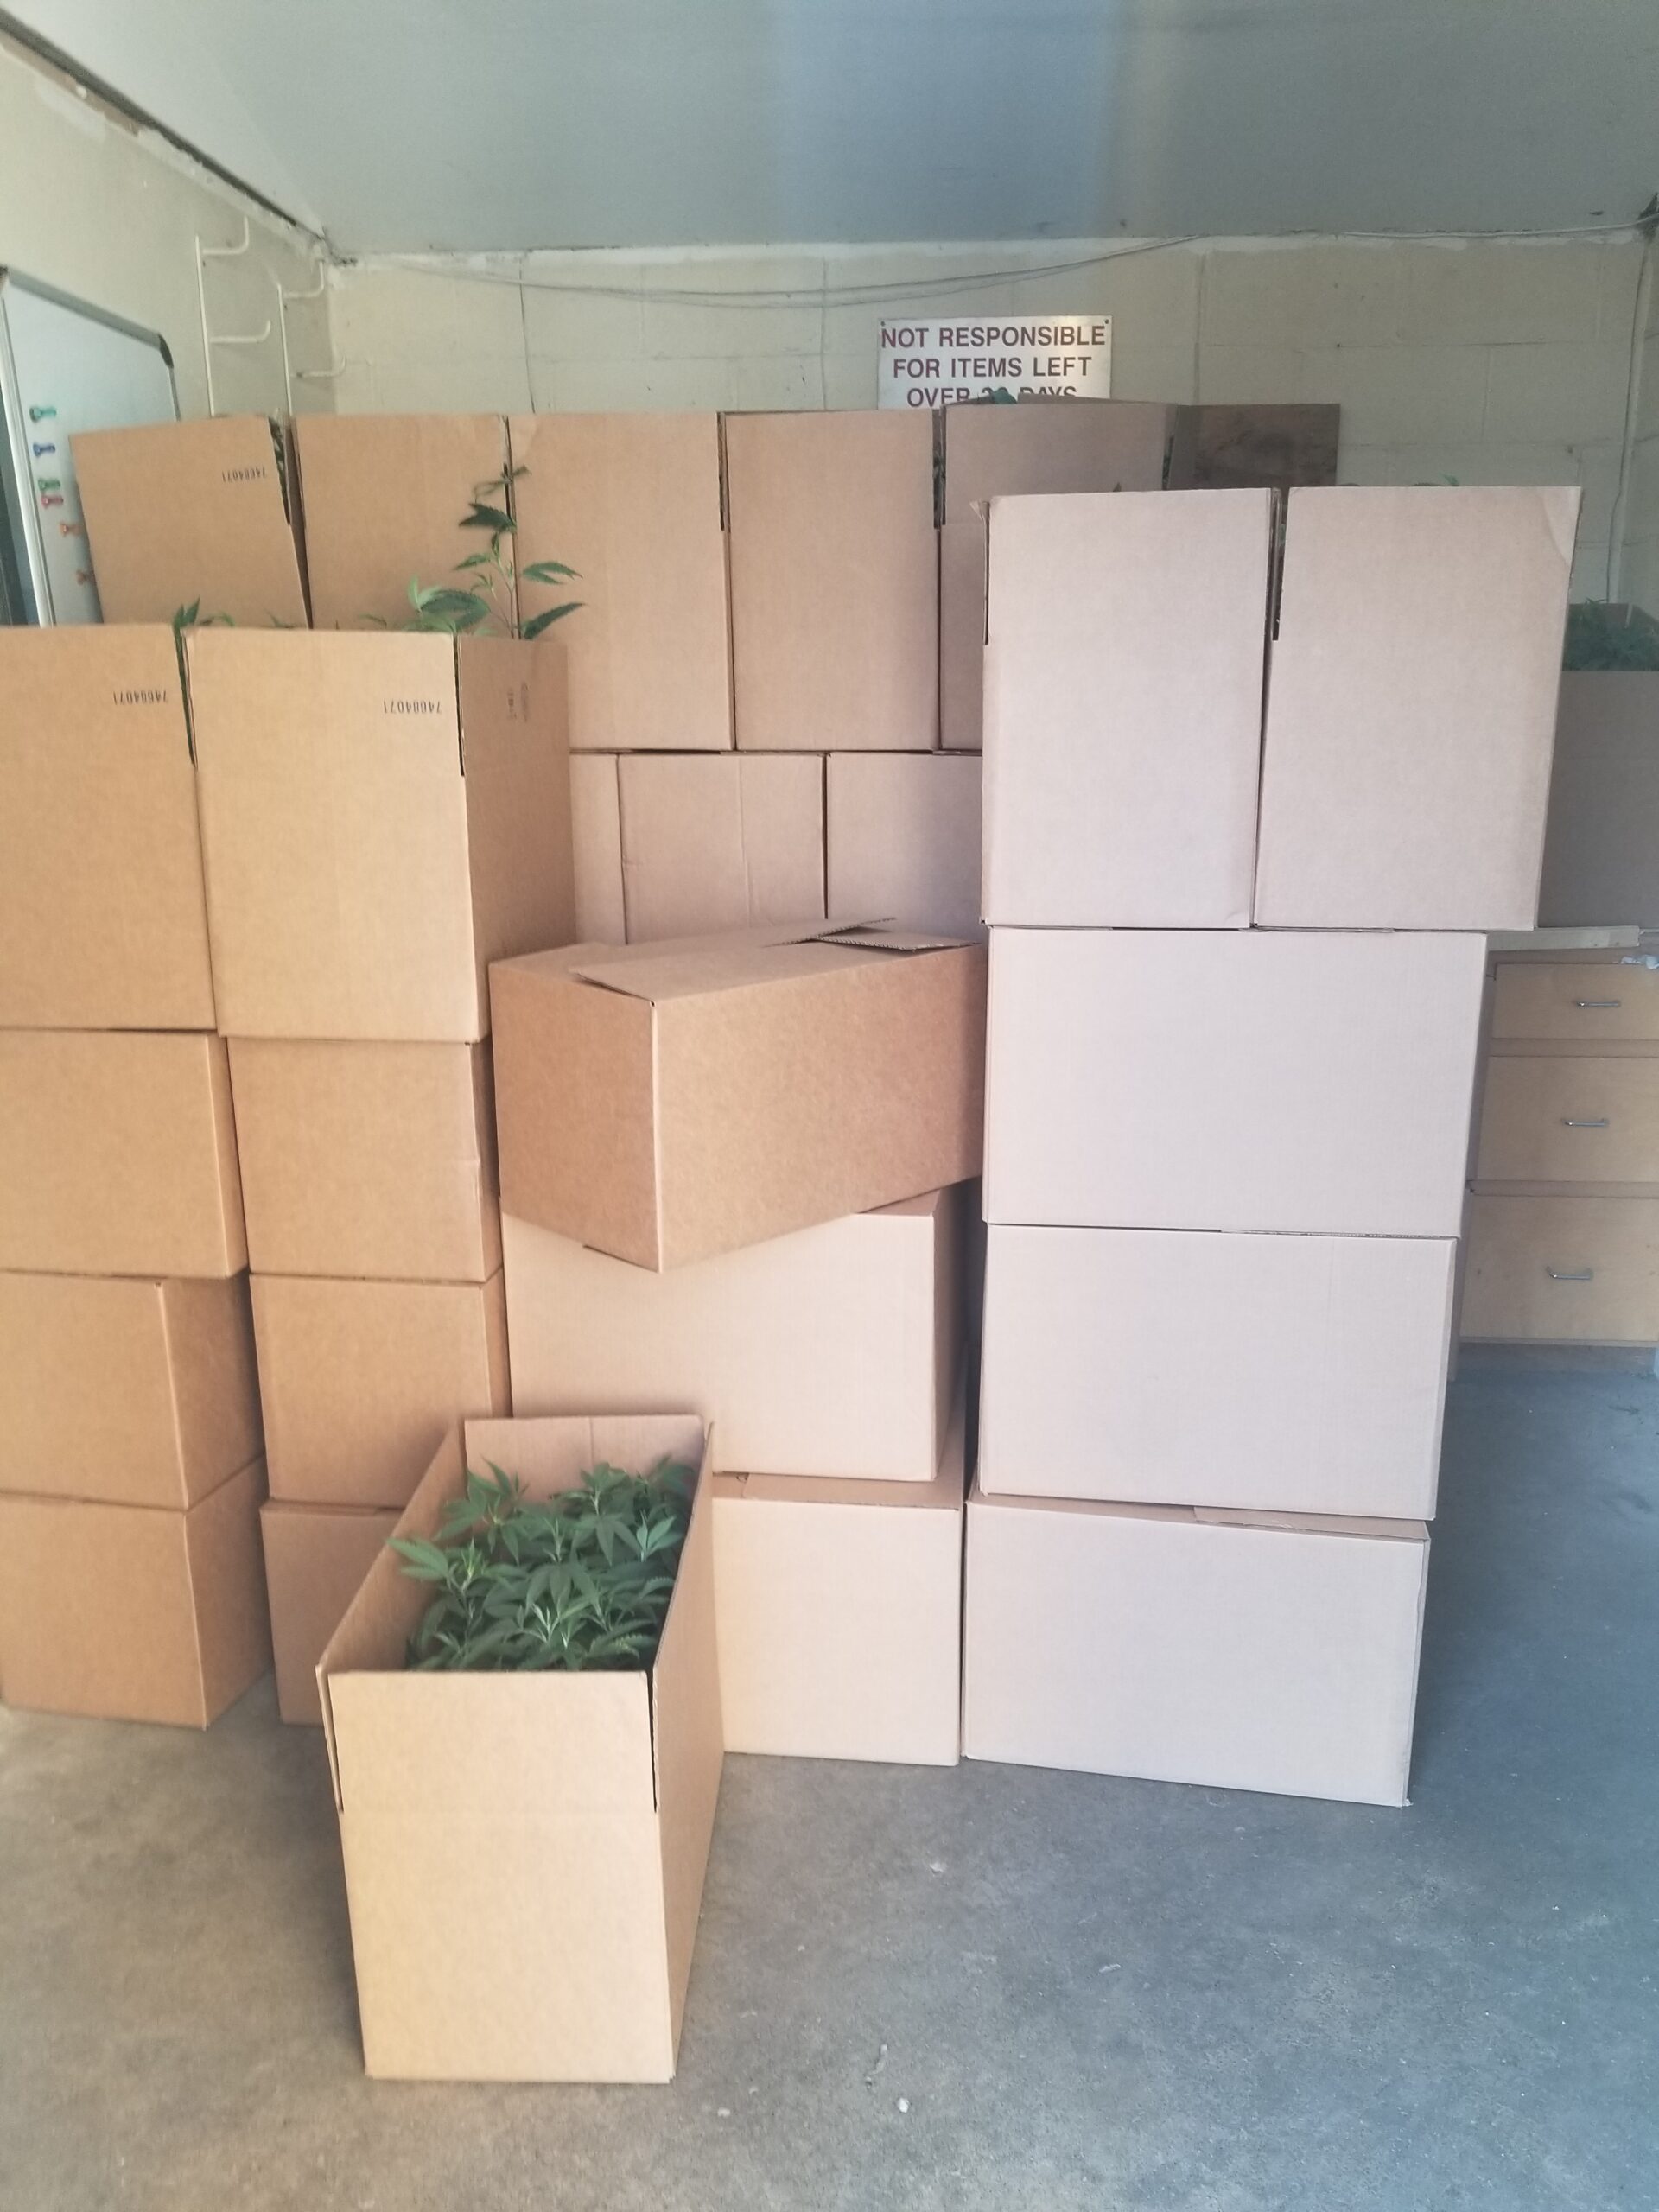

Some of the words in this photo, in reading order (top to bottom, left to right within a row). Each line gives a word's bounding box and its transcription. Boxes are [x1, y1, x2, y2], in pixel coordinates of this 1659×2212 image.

[881, 327, 929, 348] NOT
[939, 325, 1106, 347] RESPONSIBLE
[893, 359, 940, 378] FOR
[951, 357, 1022, 378] ITEMS
[1033, 356, 1092, 377] LEFT
[907, 387, 970, 407] OVER
